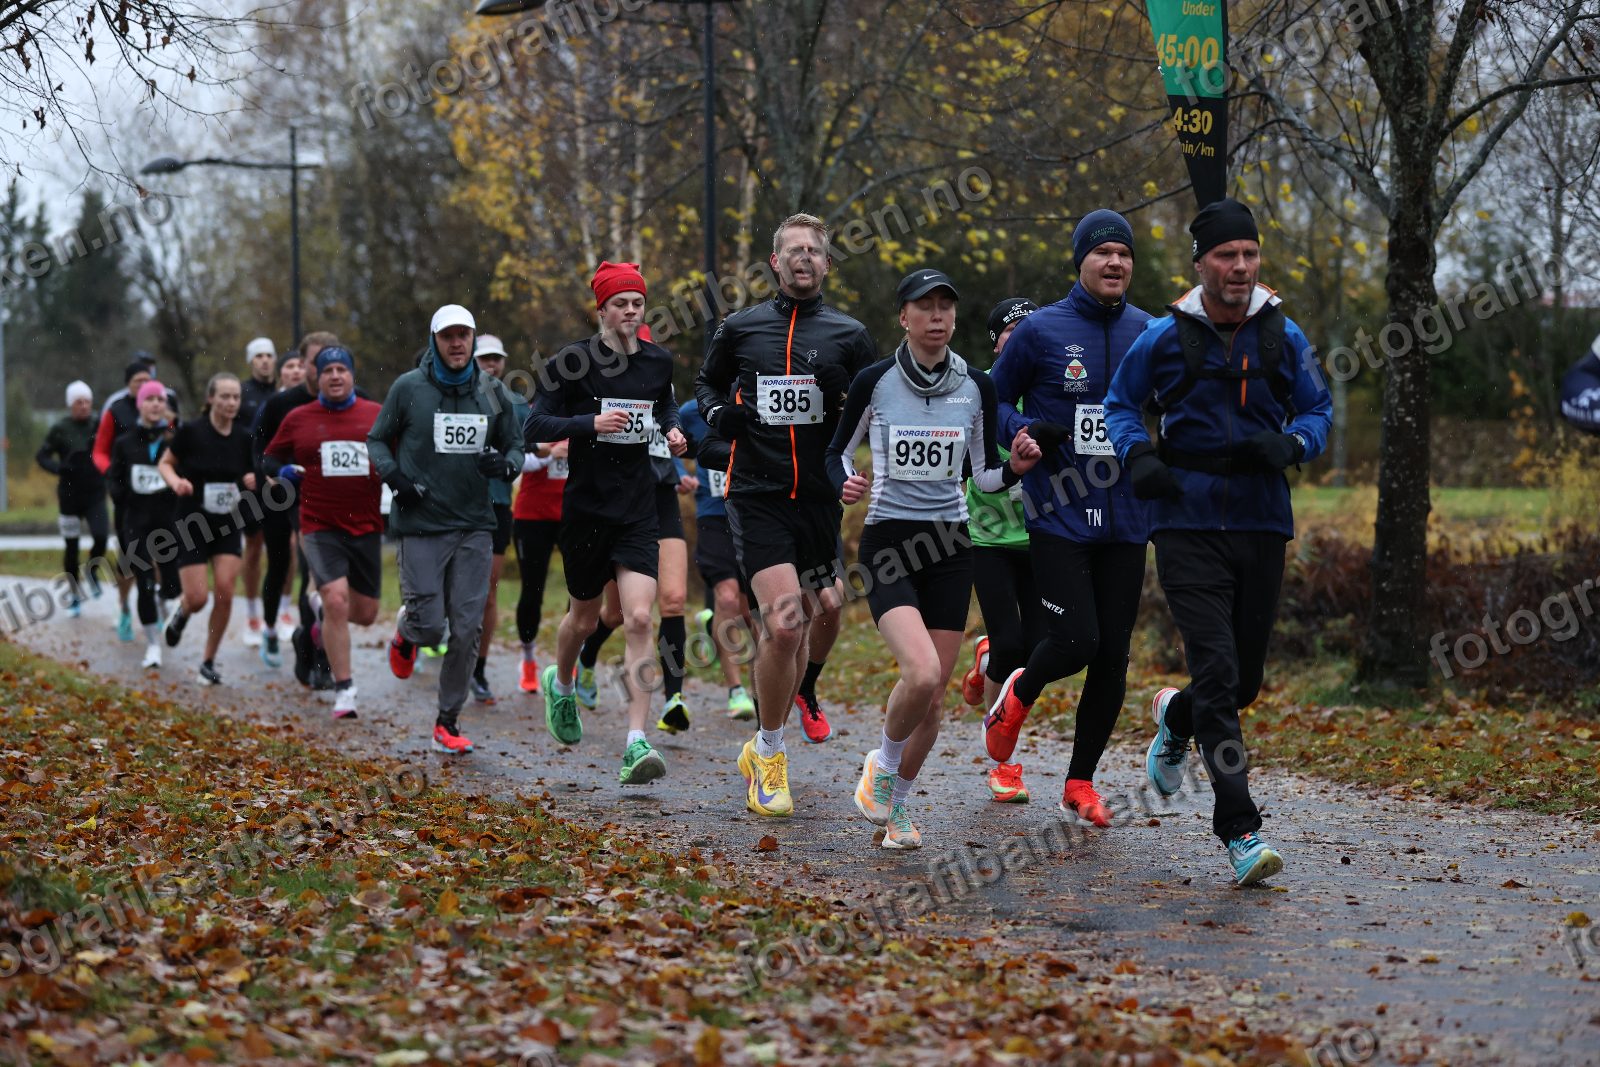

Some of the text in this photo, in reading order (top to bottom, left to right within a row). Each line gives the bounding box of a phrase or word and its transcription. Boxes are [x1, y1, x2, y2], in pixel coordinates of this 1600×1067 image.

[1182, 0, 1216, 16] Under
[1156, 33, 1219, 70] 45:00
[1173, 106, 1213, 135] 4:30
[769, 389, 811, 413] 385
[445, 426, 477, 445] 562
[896, 430, 960, 438] NORGESTESTEN
[331, 451, 360, 468] 824
[895, 440, 955, 468] 9361
[1086, 508, 1102, 527] TN
